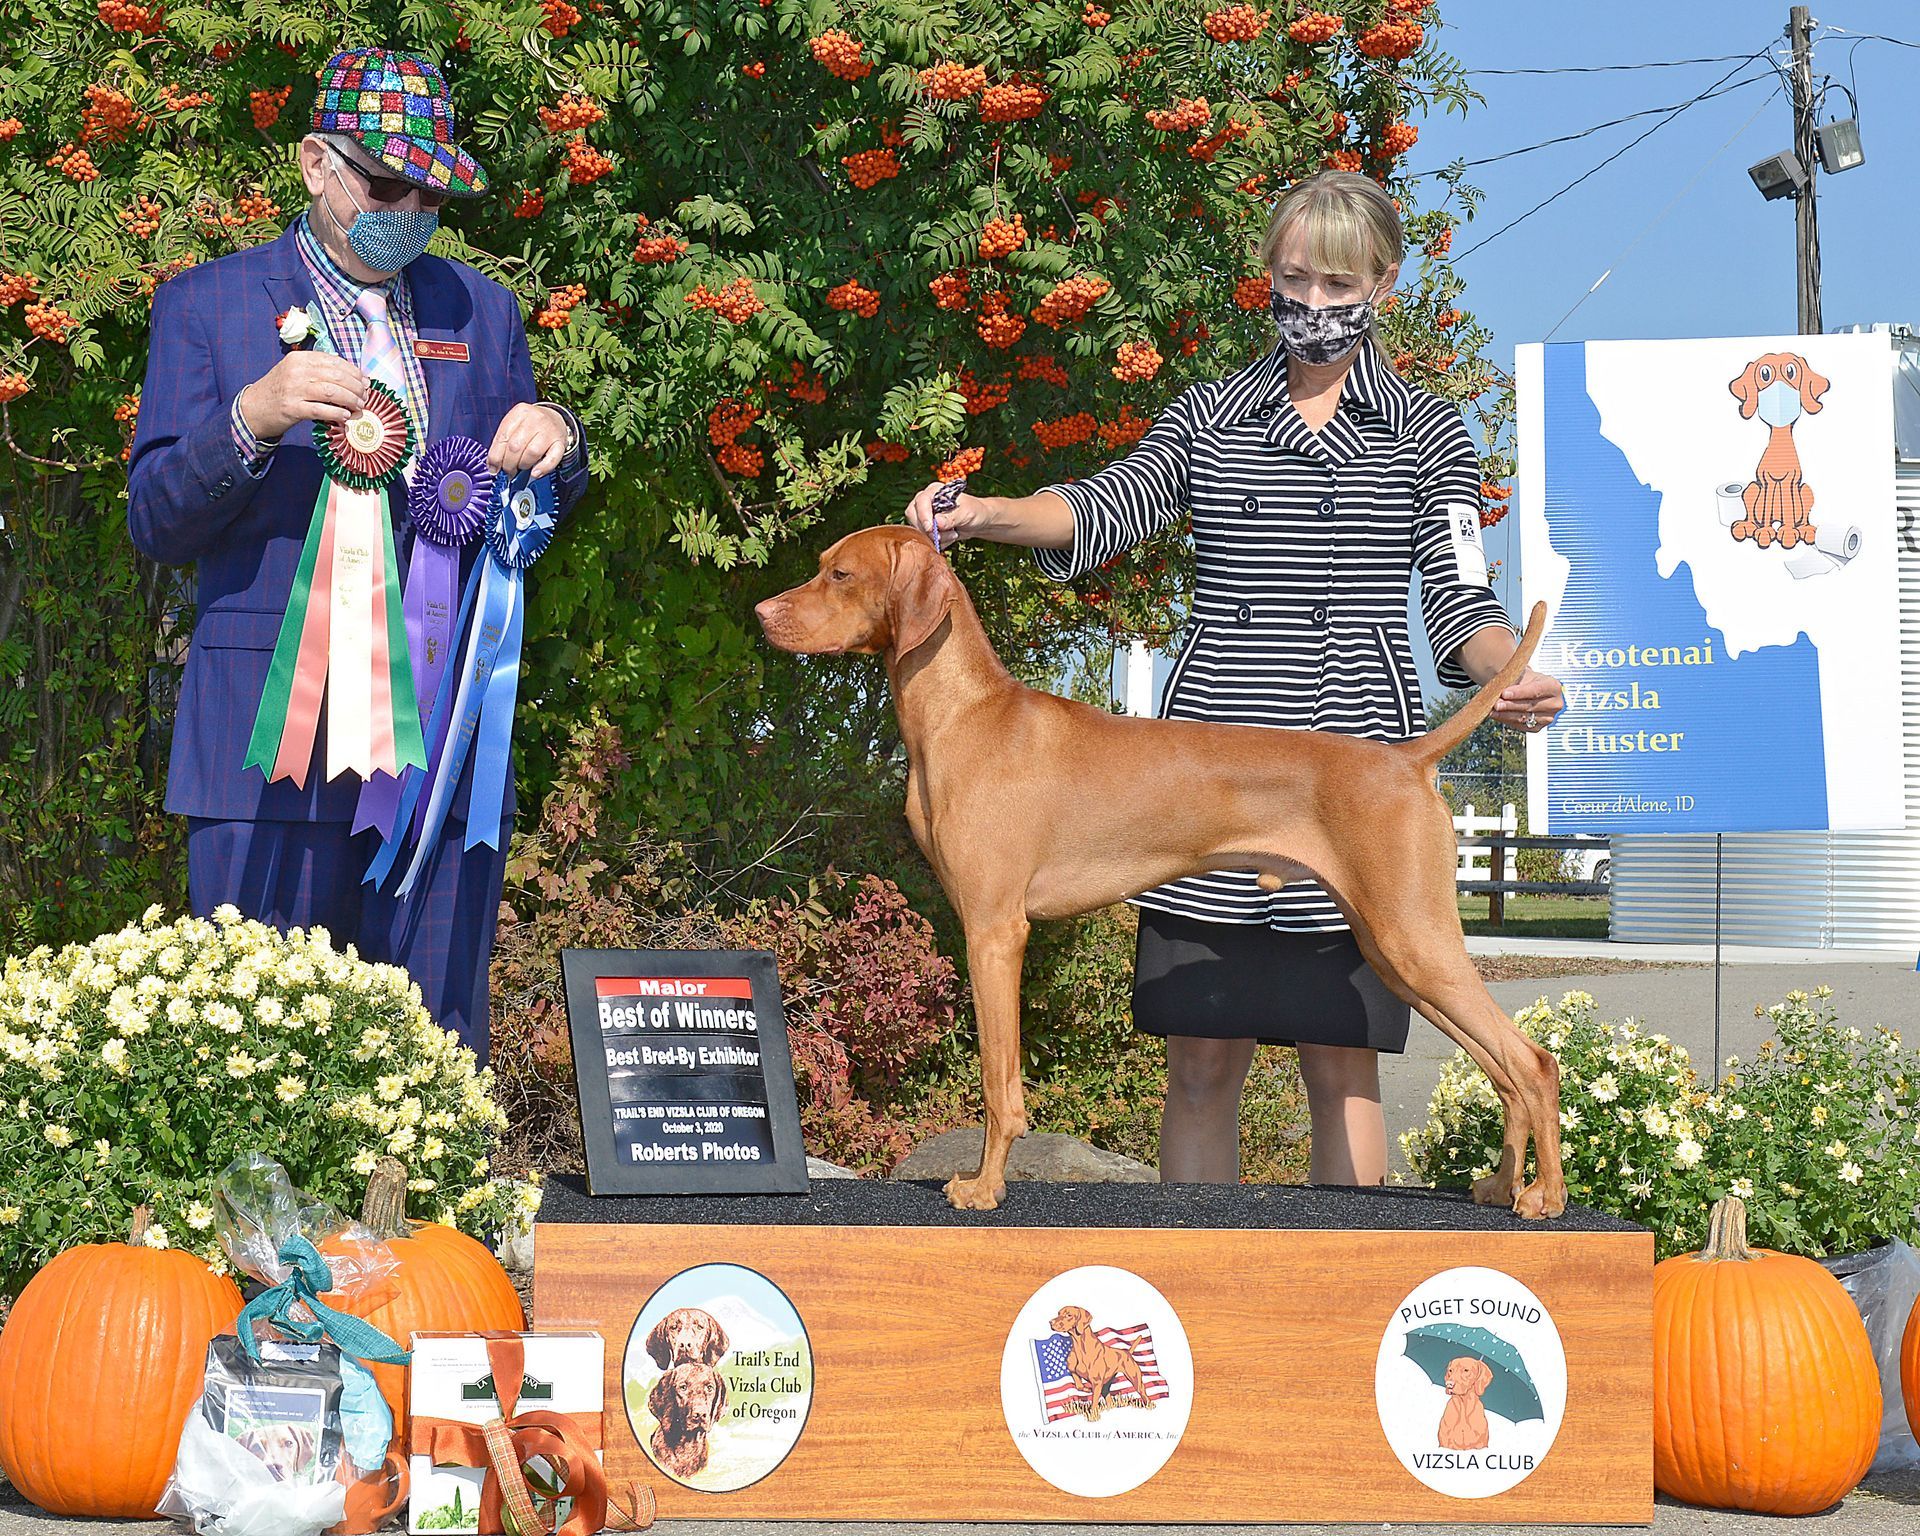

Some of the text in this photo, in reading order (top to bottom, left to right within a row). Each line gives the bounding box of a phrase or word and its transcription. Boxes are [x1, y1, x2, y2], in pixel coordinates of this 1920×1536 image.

[1560, 637, 1715, 668] Kootenai
[1561, 681, 1662, 710] Vizsla
[1559, 726, 1685, 754] Cluster
[1561, 794, 1696, 815] Coeur d'Alene, ID
[639, 979, 708, 997] Major
[599, 1000, 758, 1031] Best of Winners
[605, 1046, 760, 1070] Best Bred-By Exhibitor
[614, 1106, 766, 1119] TRAIL'S END VIZSLA CLUB OF OREGON
[662, 1121, 724, 1135] October 3, 2020
[630, 1142, 761, 1162] Roberts Photos
[1400, 1298, 1542, 1325] PUGET SOUND
[732, 1350, 800, 1368] Trail's End
[728, 1376, 802, 1394] Vizsla Club
[732, 1401, 797, 1424] of Oregon
[1018, 1430, 1030, 1439] the
[1102, 1430, 1112, 1441] of
[1412, 1453, 1535, 1471] VIZSLA CLUB
